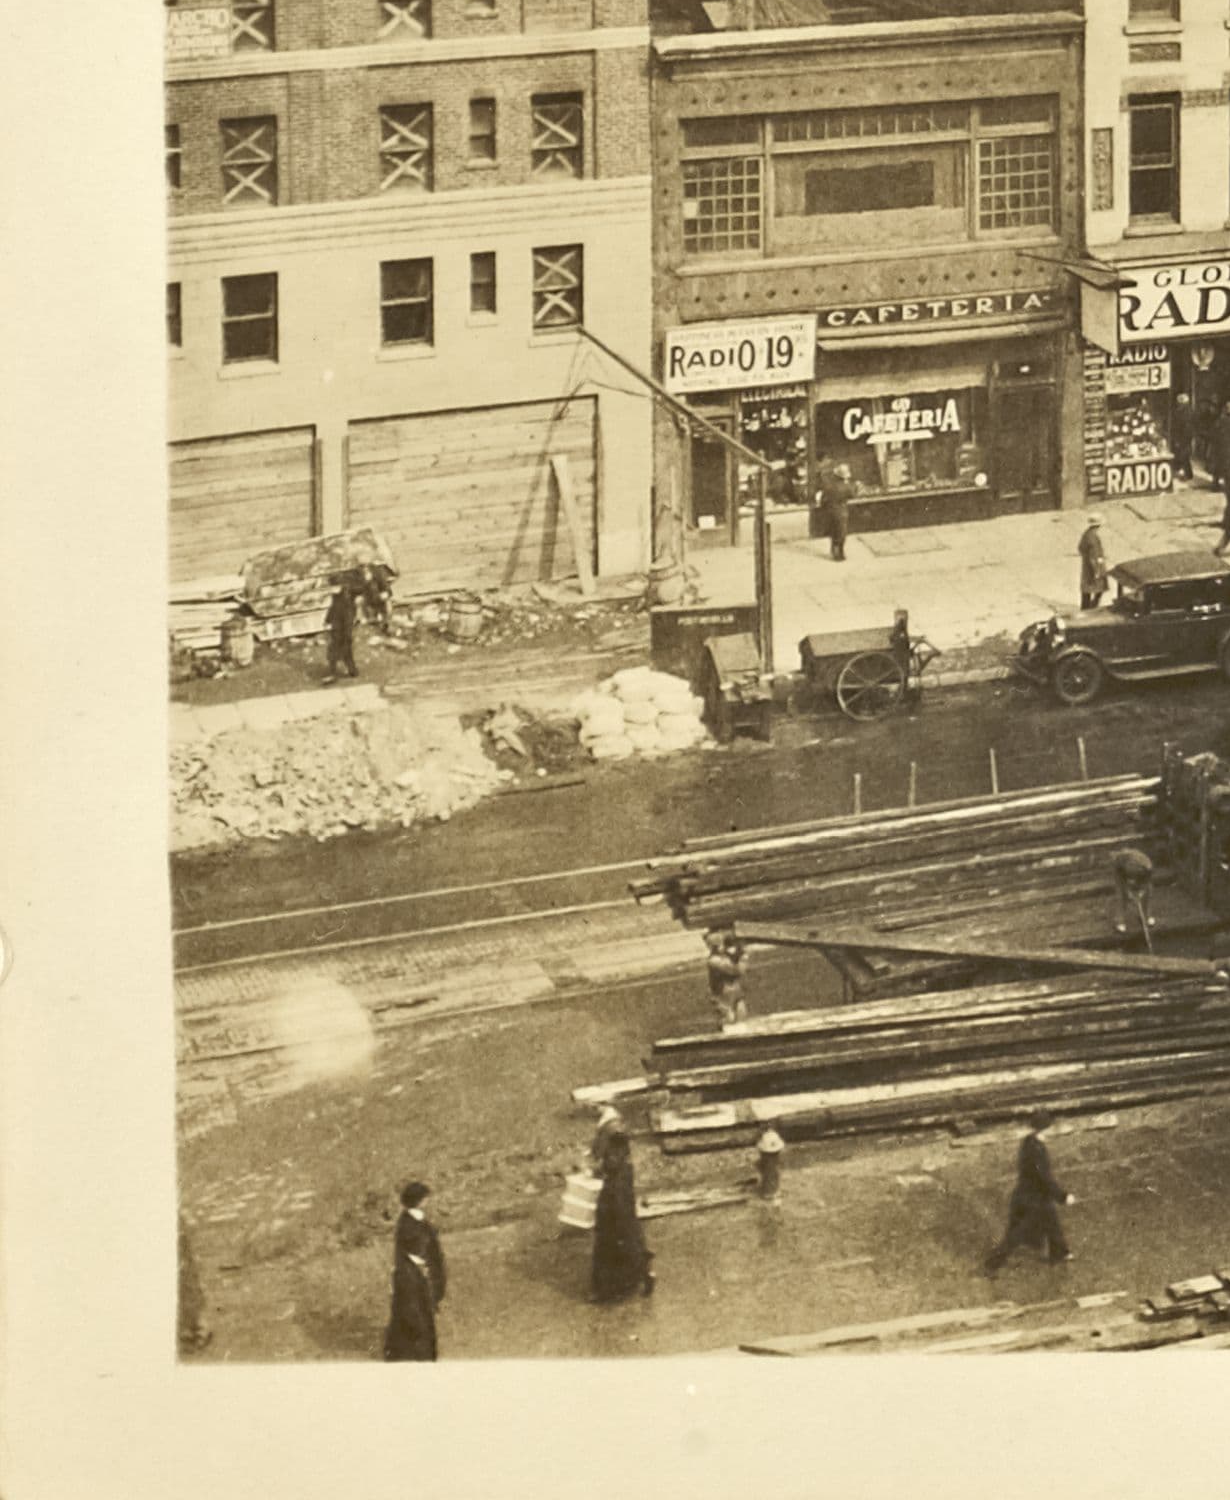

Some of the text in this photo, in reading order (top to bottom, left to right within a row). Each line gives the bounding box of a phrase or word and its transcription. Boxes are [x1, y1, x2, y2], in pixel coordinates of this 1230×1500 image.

[827, 293, 1042, 326] CAFETERIA
[670, 335, 794, 378] RADIO 19
[843, 398, 961, 441] CAFETERIA
[1106, 462, 1172, 495] RADIO
